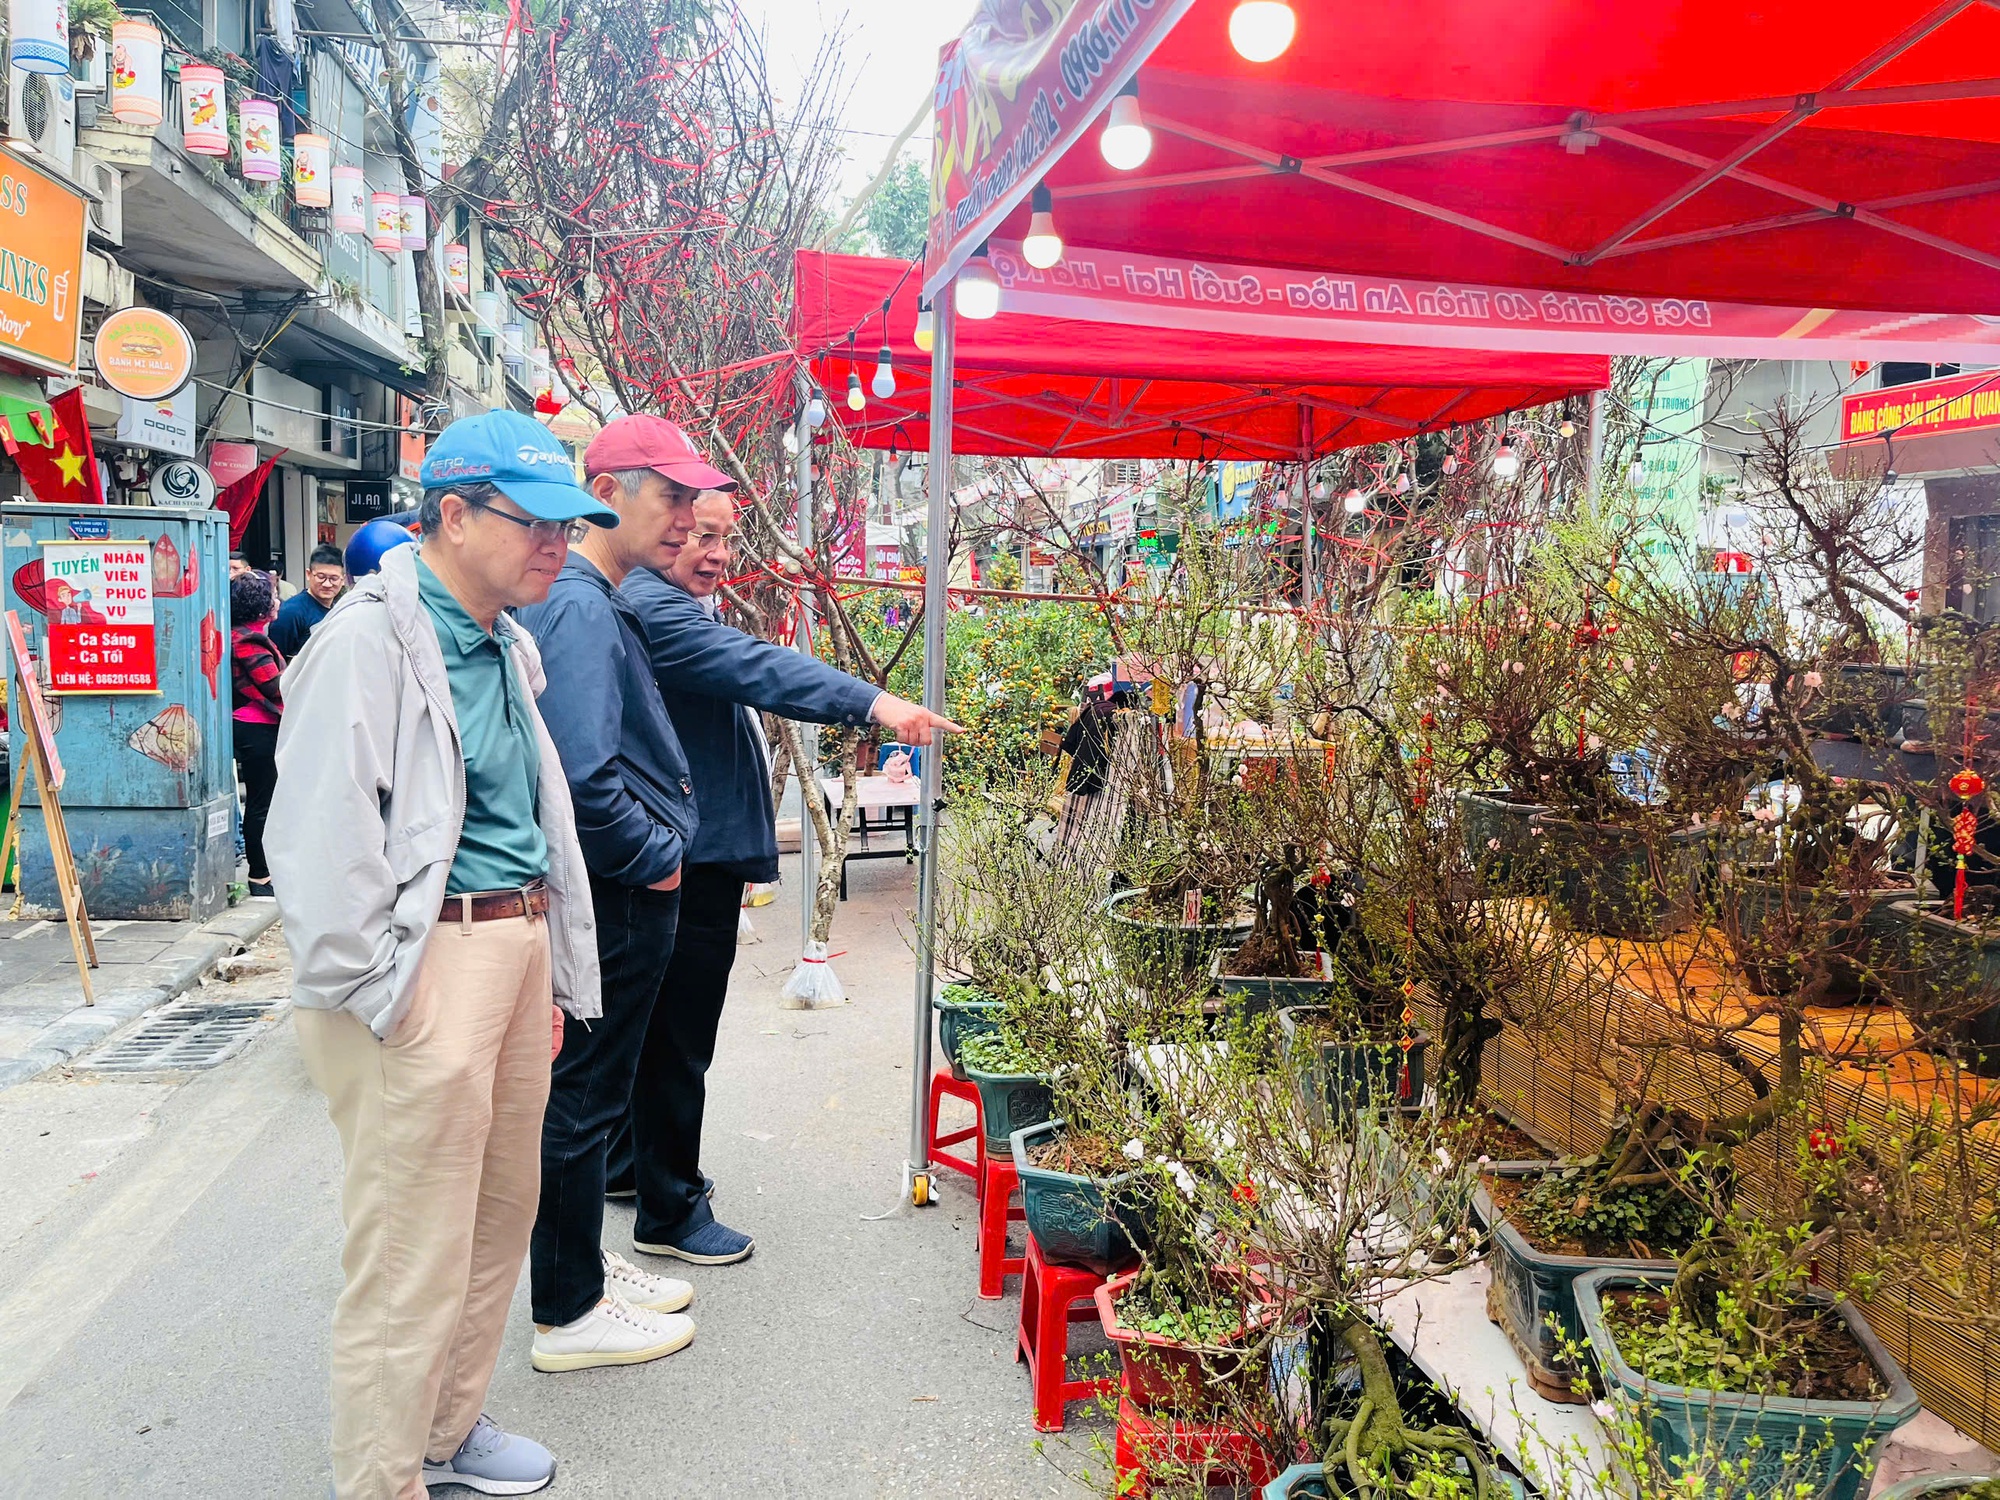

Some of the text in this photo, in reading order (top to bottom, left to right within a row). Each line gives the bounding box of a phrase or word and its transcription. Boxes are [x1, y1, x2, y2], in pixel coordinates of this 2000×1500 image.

[335, 230, 360, 263] HOSTEL
[1850, 402, 1875, 435] ĐẢNG
[1903, 393, 1923, 427] SẢN
[1925, 394, 1946, 428] VIỆT
[1947, 394, 1972, 420] NAM
[433, 465, 491, 478] BURNER
[352, 494, 380, 505] JI.AN
[52, 551, 99, 576] TUYỂN
[104, 550, 145, 564] NHÂN
[104, 568, 138, 582] VIÊN
[106, 588, 147, 601] PHỤC
[106, 606, 126, 620] VỤ
[79, 633, 98, 646] Ca
[102, 633, 136, 648] Sáng
[80, 651, 98, 663] Ca
[102, 649, 123, 664] Tối
[56, 673, 151, 686] LIÊN HỆ: 0862014588
